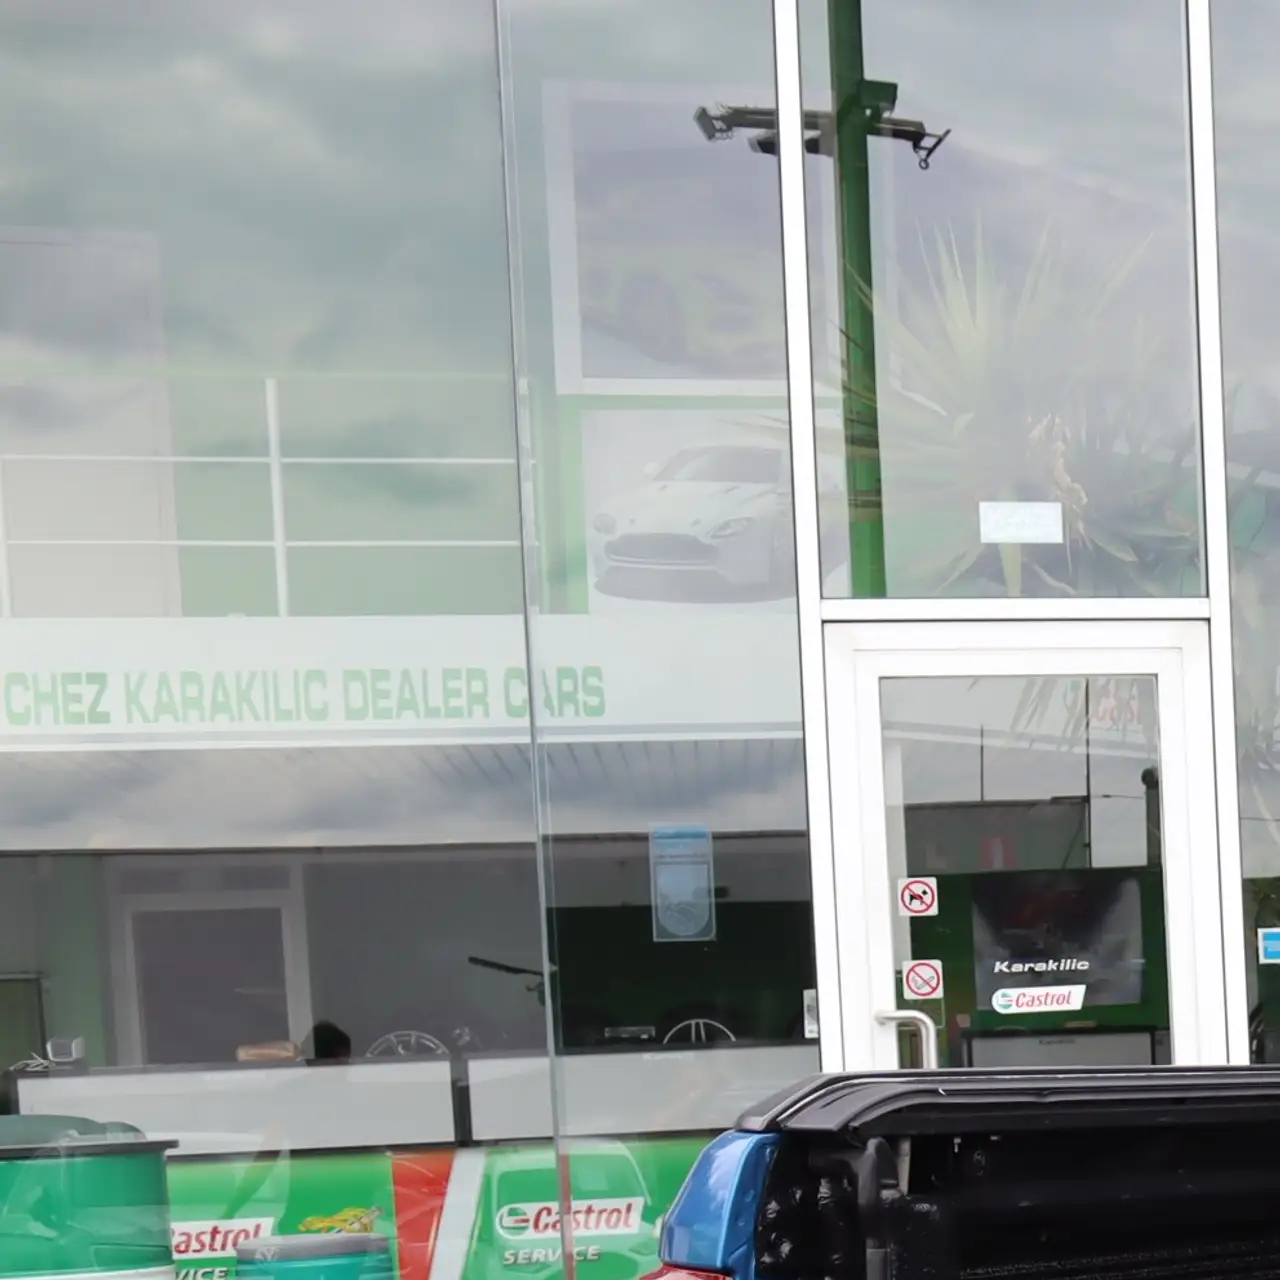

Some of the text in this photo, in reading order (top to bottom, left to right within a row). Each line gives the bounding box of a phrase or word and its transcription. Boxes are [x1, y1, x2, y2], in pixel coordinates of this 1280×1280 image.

[3, 671, 111, 726] CHEZ
[123, 668, 329, 724] KARAKILIC
[343, 667, 490, 721] DEALER
[994, 959, 1090, 973] Karakilic
[1015, 990, 1072, 1009] Castrol
[503, 1245, 600, 1265] SERVCE
